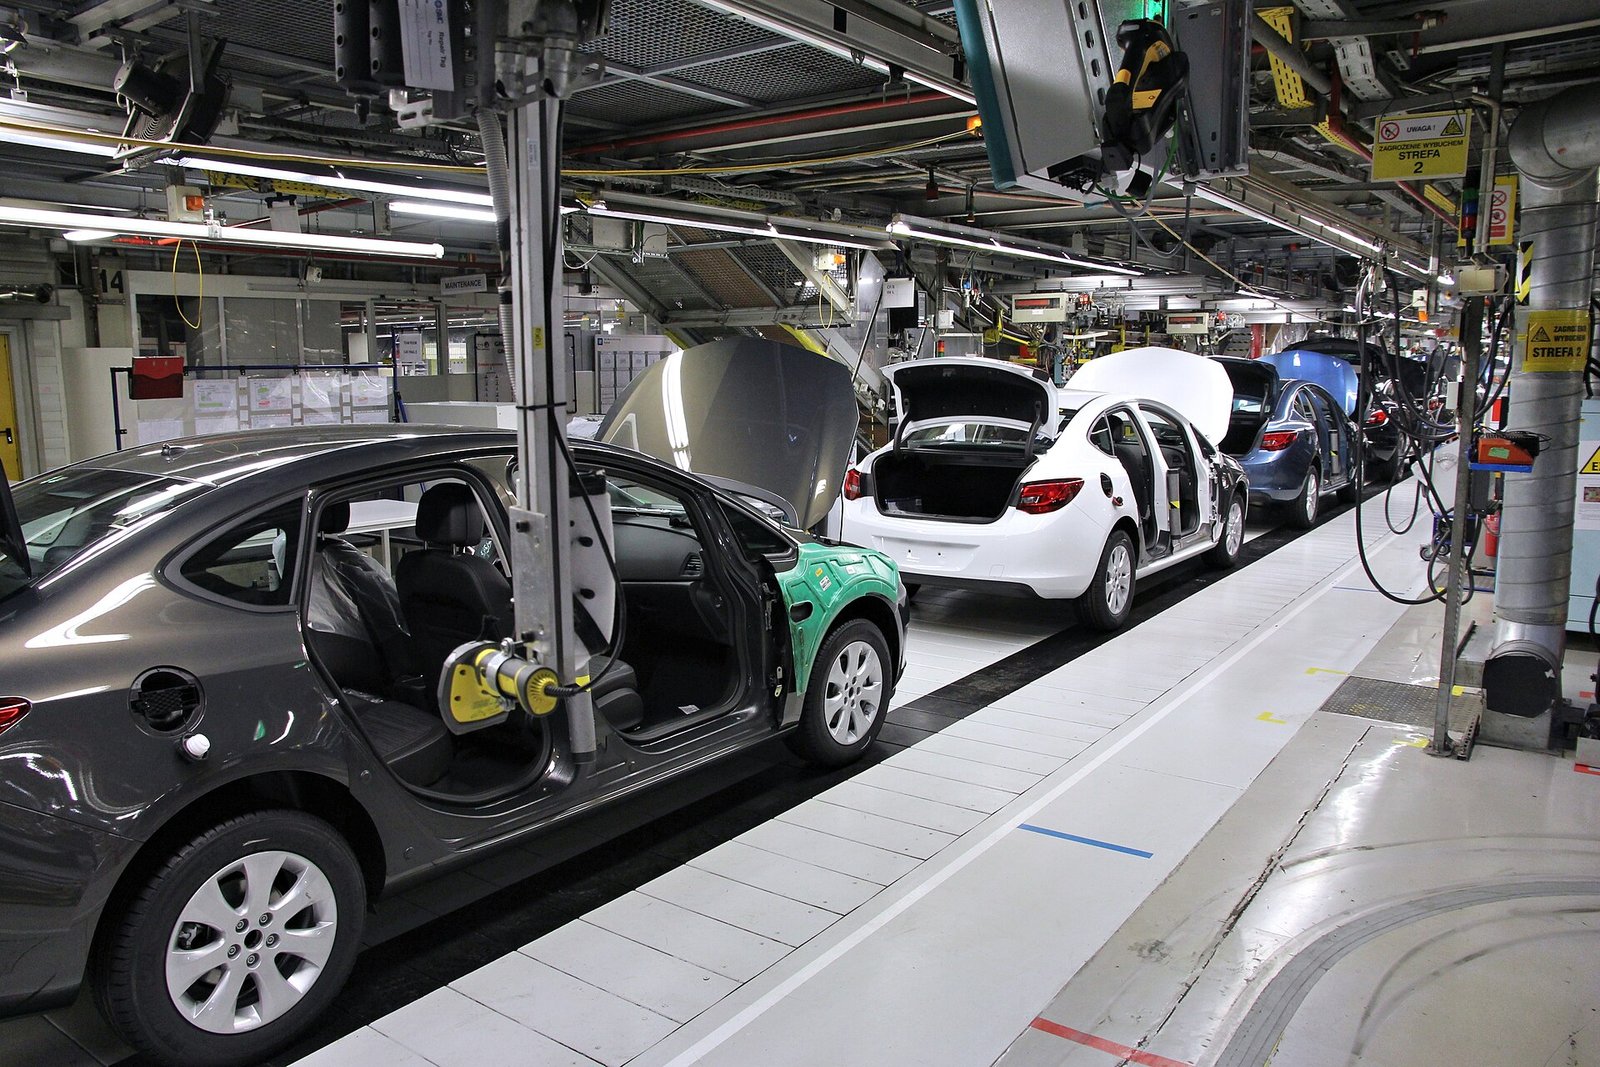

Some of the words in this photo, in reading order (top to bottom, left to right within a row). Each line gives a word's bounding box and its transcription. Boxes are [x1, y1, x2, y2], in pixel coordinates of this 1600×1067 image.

[1406, 125, 1432, 133] UWAGA
[1423, 139, 1464, 149] WYBUCHEM
[1398, 149, 1440, 161] STREFA
[1413, 161, 1423, 174] 2
[100, 269, 124, 294] 14
[444, 279, 482, 289] MAINTENANCE
[1532, 346, 1574, 358] STREFA
[1576, 346, 1582, 357] 2
[1592, 461, 1600, 471] E
